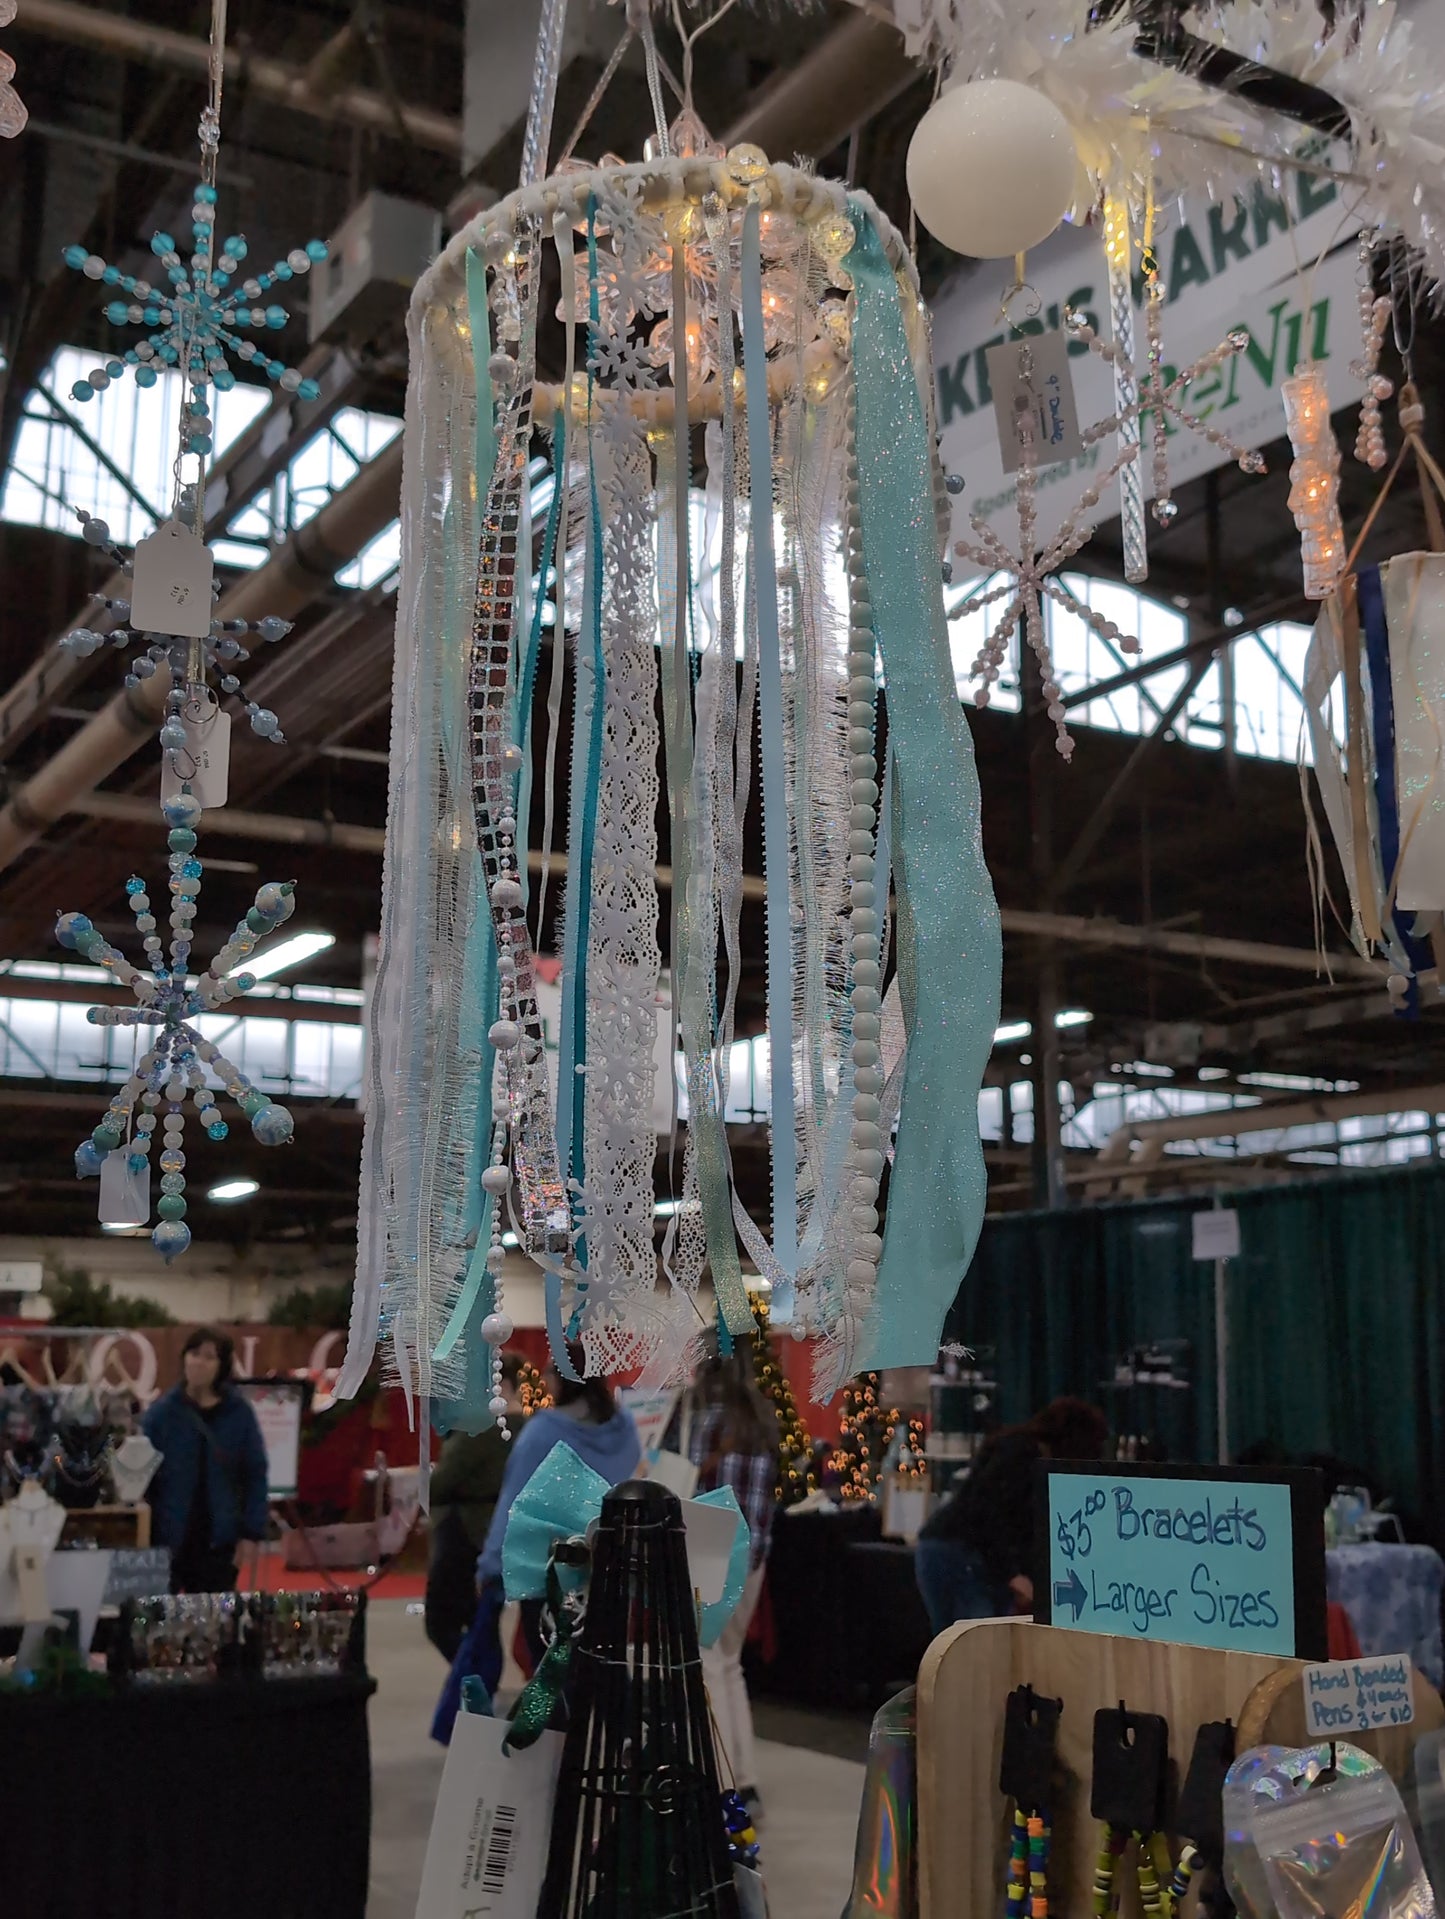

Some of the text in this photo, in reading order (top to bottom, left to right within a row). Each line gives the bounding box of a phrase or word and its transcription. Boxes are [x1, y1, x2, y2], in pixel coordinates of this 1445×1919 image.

[1111, 1486, 1267, 1551] Bracelets
[1091, 1563, 1279, 1632] Larger Sizes
[1309, 1668, 1350, 1694] Hand
[1311, 1700, 1354, 1727] Pens
